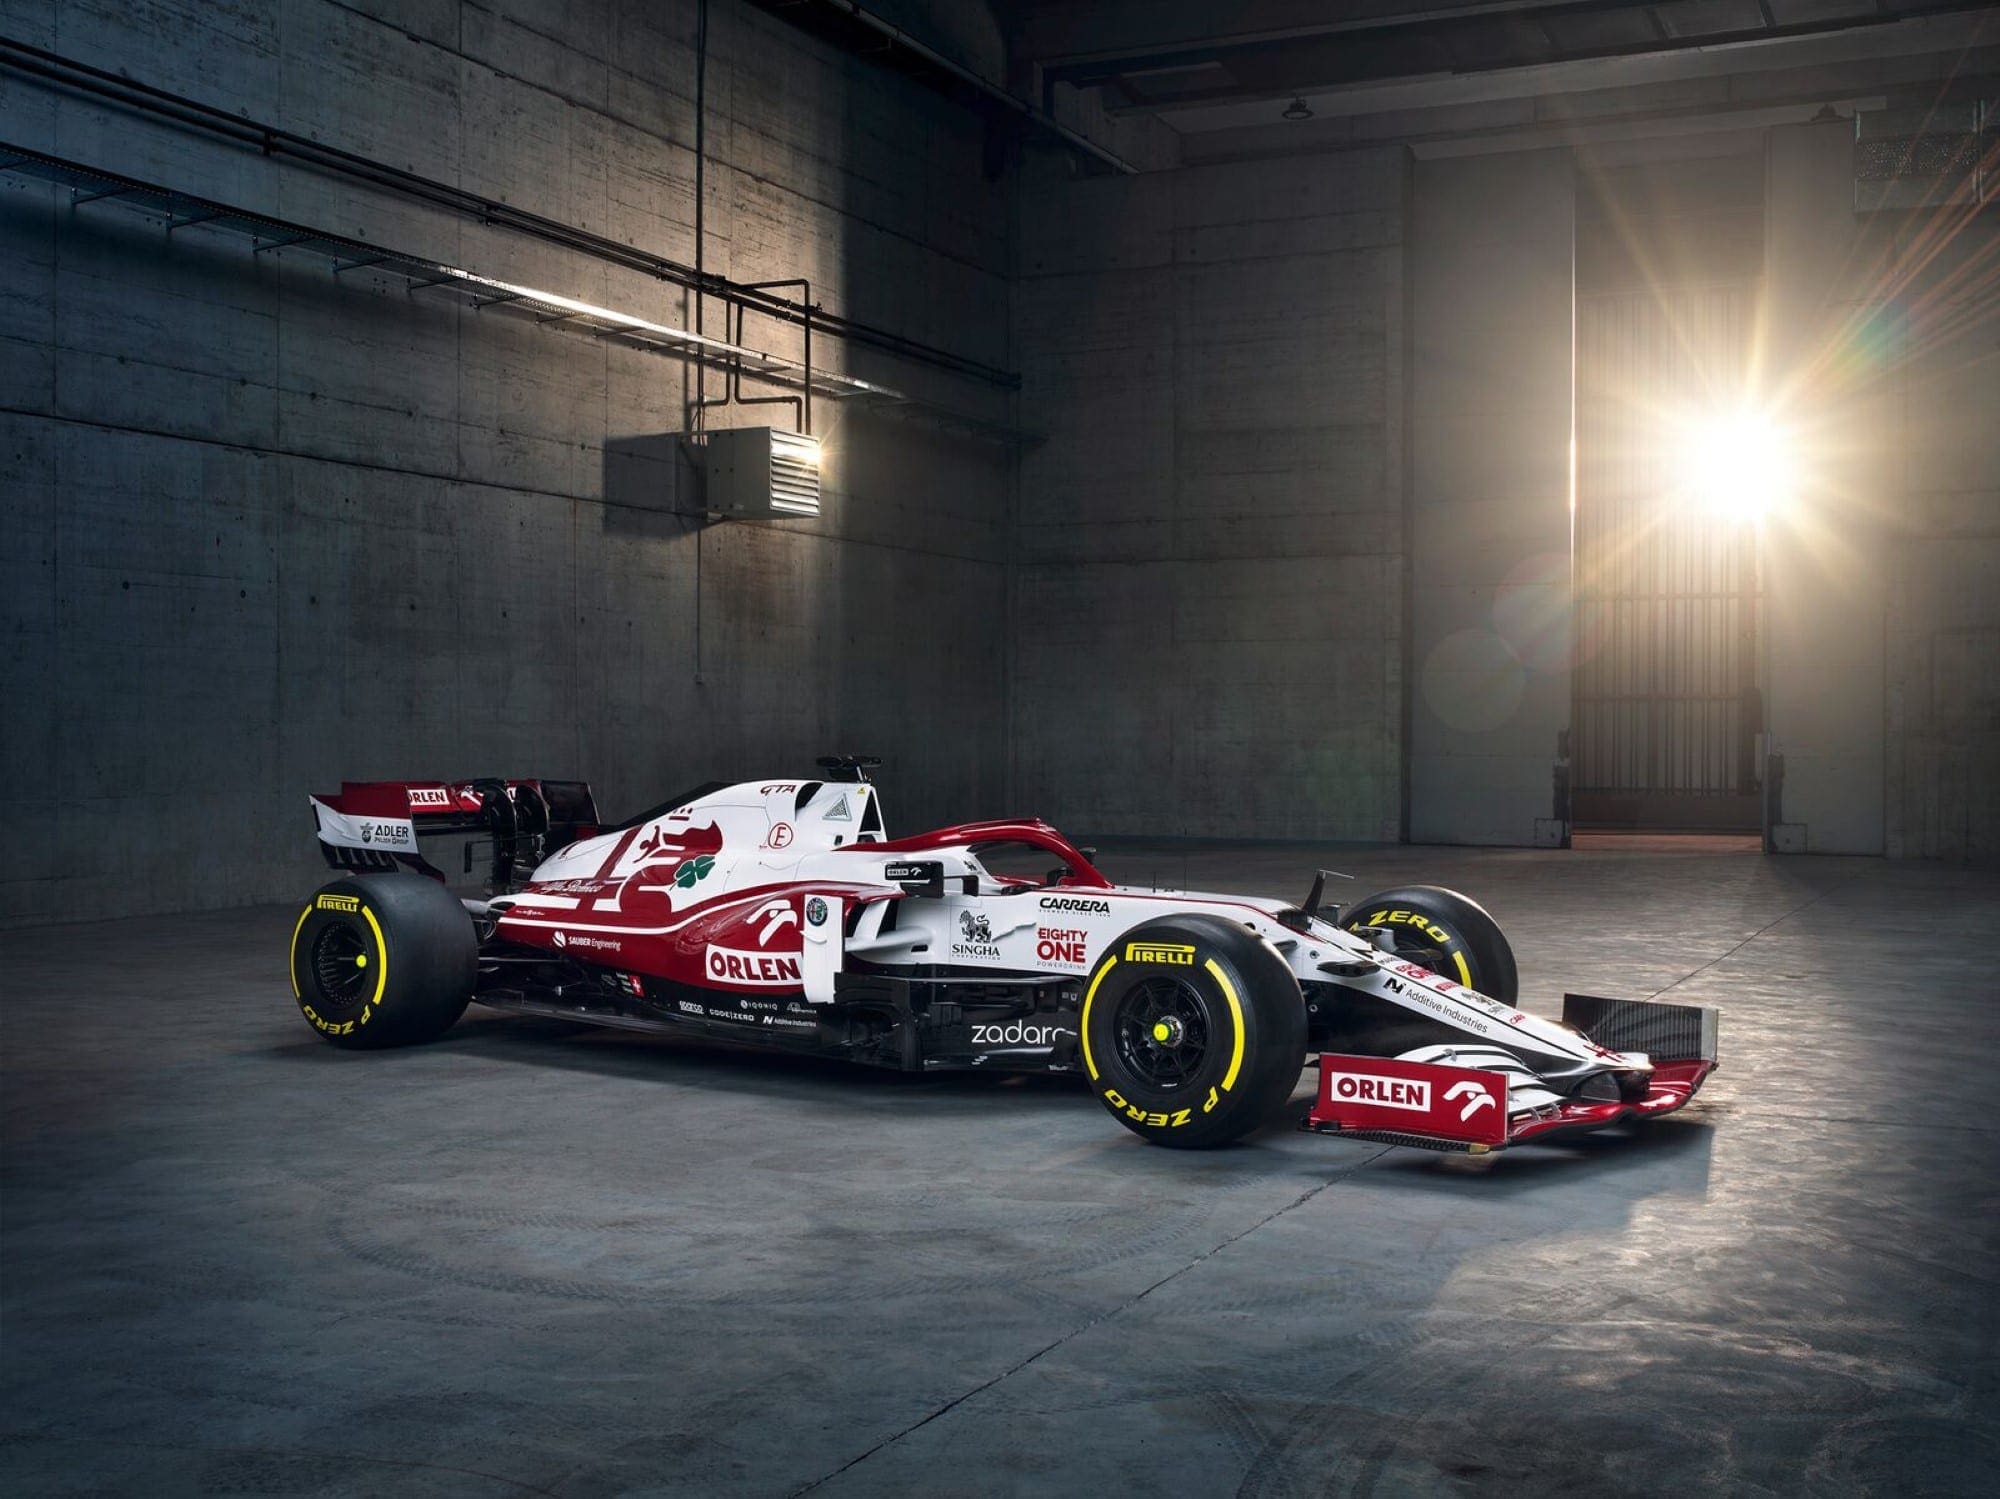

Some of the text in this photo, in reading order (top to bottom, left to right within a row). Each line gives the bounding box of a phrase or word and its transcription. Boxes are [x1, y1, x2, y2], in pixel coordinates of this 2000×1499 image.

[760, 784, 797, 796] GTA
[375, 824, 409, 838] ADLER
[774, 826, 787, 847] E
[317, 894, 360, 913] PIRELLI
[1039, 897, 1110, 914] CARRERA
[1037, 927, 1088, 942] EIGHTY
[1368, 910, 1451, 943] ZERO
[568, 936, 591, 947] SAUBER
[951, 944, 1001, 957] SINGHA
[1036, 940, 1087, 964] ONE
[1125, 942, 1196, 965] PIRELLI
[710, 951, 802, 981] ORLEN
[303, 1004, 355, 1036] ZERO
[1405, 988, 1442, 1012] Additive
[1442, 1002, 1489, 1034] Industries
[1337, 1077, 1425, 1107] ORLEN
[1104, 1086, 1219, 1128] P ZERO
